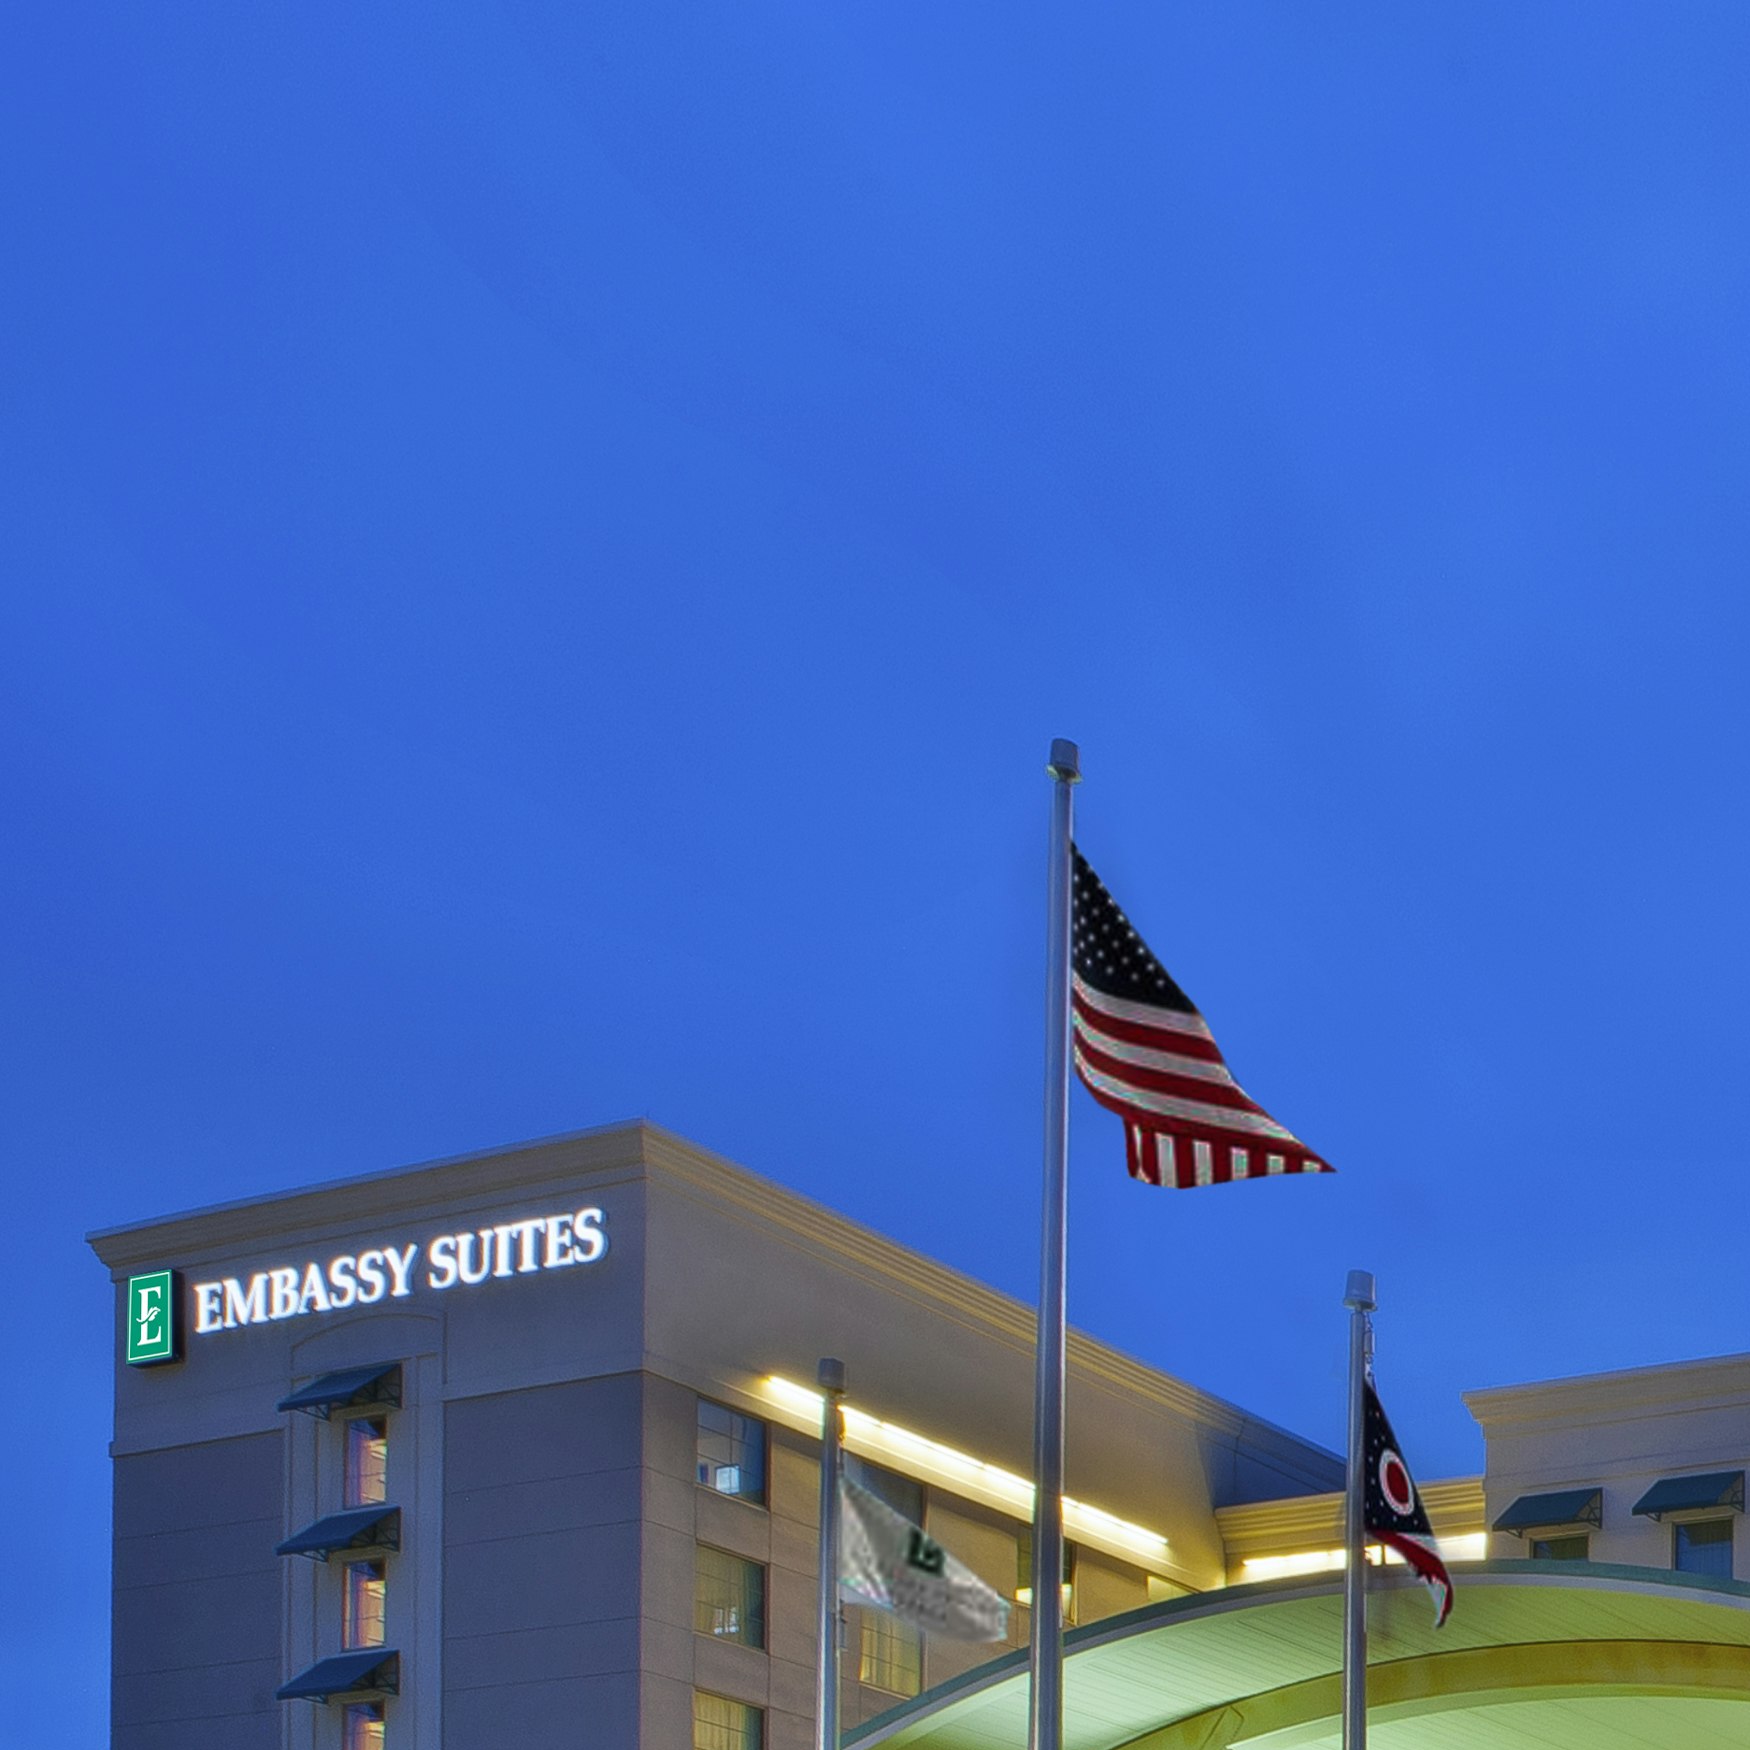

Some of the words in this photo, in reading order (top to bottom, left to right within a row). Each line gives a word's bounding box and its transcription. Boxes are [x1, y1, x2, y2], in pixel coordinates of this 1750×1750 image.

[136, 1286, 162, 1346] E
[194, 1243, 418, 1334] EMBASSY
[428, 1207, 608, 1290] SUITES
